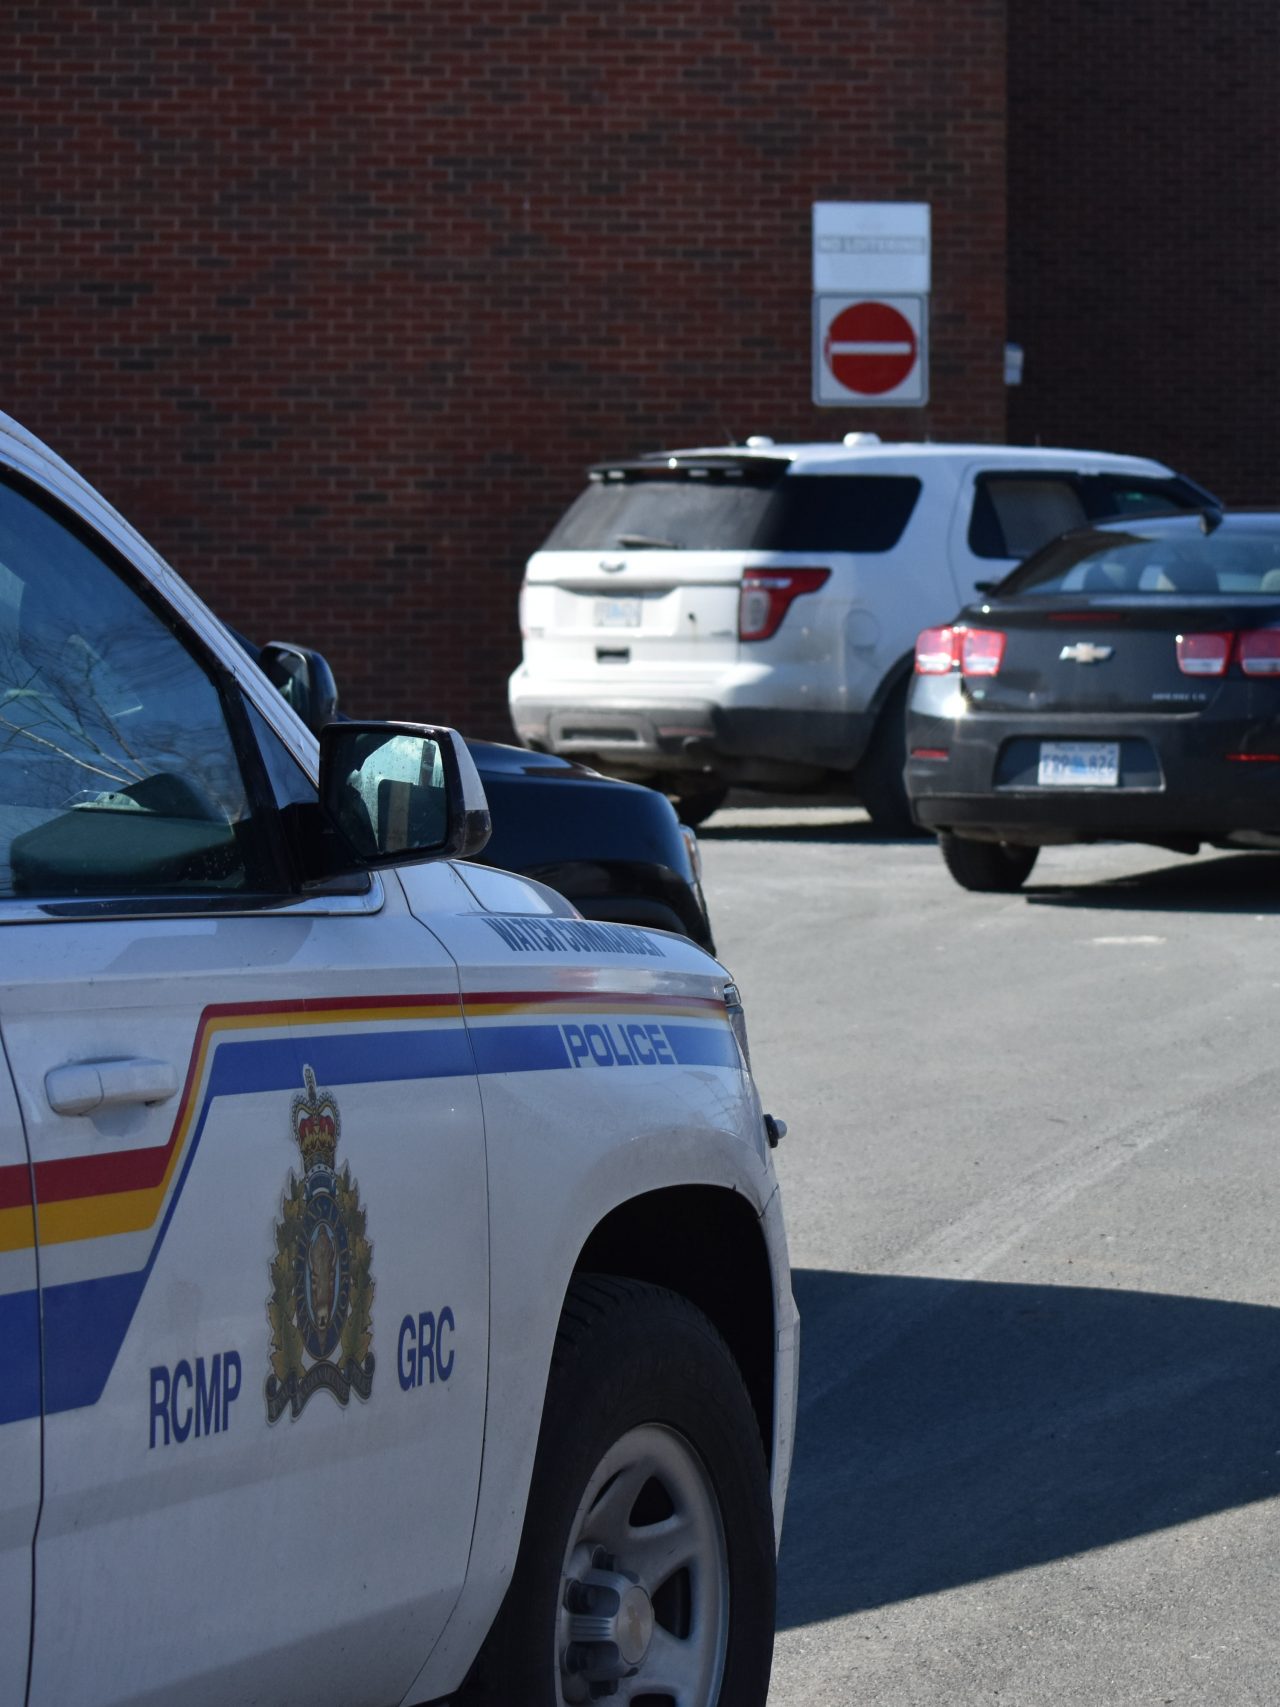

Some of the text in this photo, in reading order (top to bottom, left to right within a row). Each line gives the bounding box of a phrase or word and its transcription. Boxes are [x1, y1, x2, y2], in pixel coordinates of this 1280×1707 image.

[480, 918, 667, 958] WATCH COMMANDER
[562, 1024, 676, 1068] POLICE
[398, 1305, 456, 1391] GRC
[149, 1350, 242, 1449] RCMP
